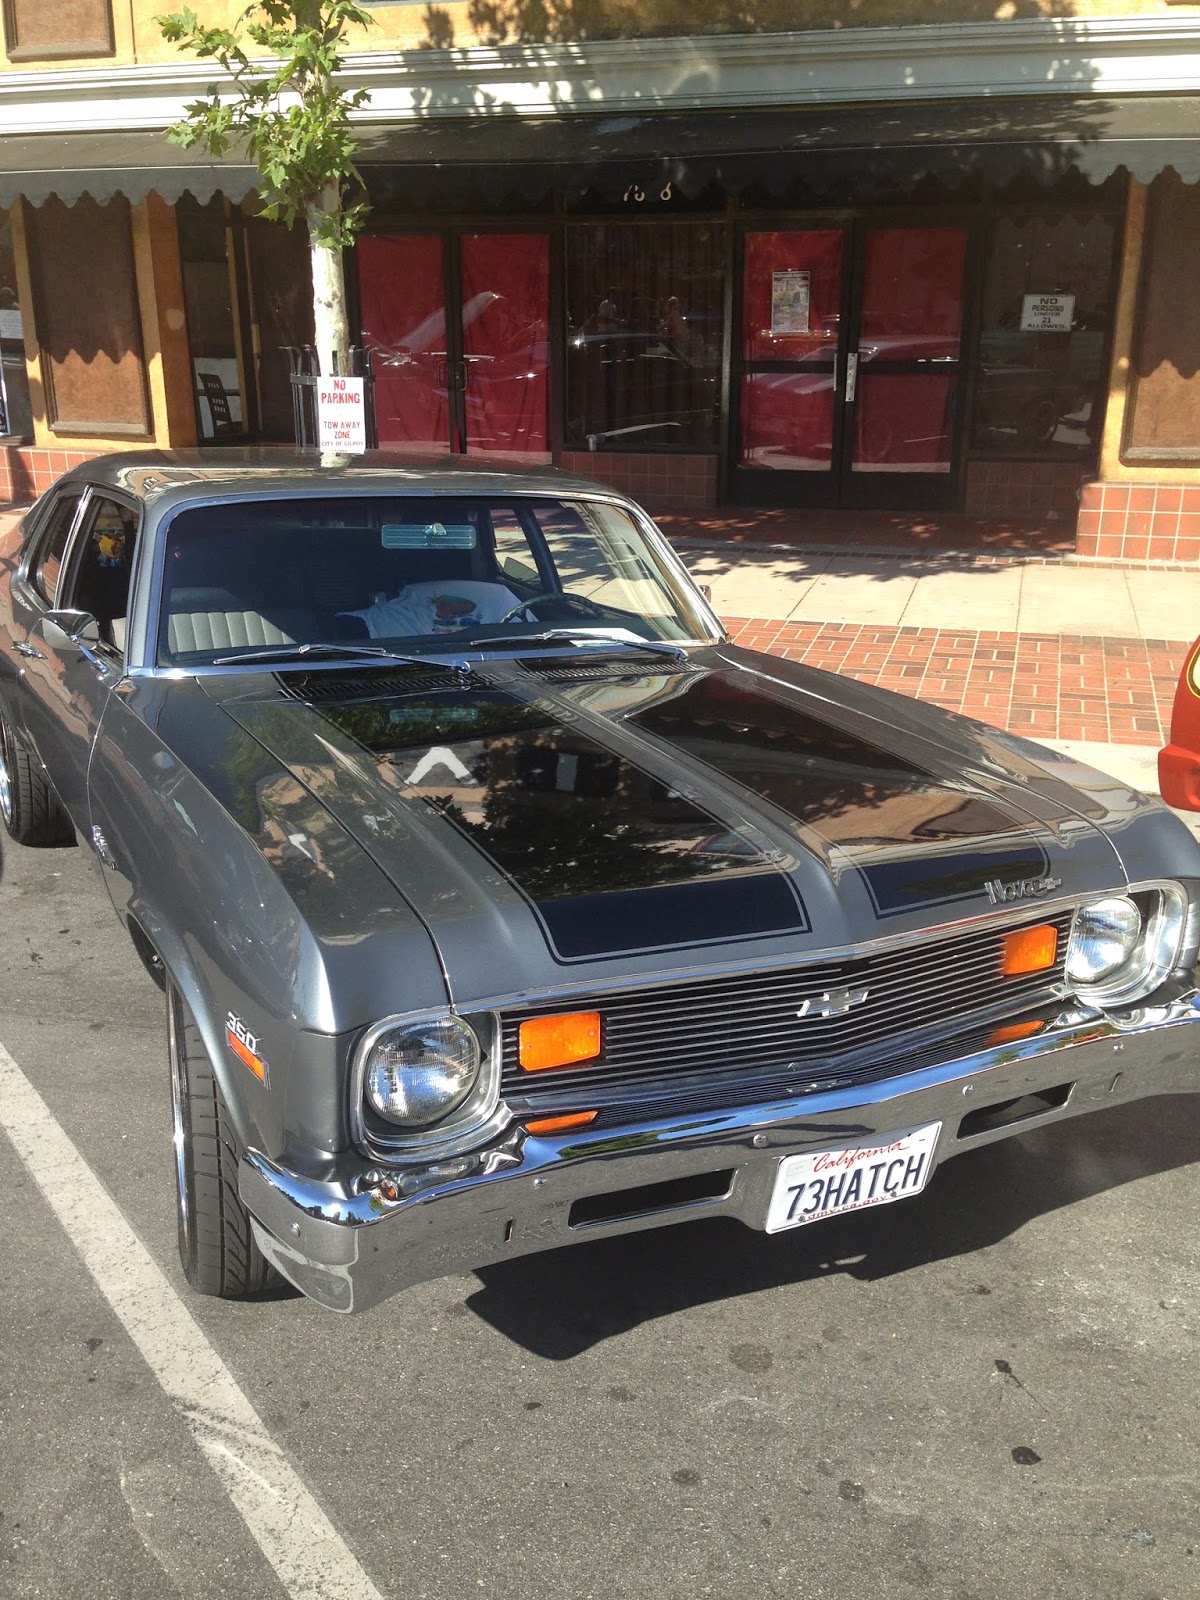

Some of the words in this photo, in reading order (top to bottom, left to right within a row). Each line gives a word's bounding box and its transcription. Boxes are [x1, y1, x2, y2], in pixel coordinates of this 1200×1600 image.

[1040, 297, 1058, 305] NO
[1032, 304, 1064, 312] PERSONS
[1042, 316, 1051, 324] 21
[333, 379, 346, 391] NO
[321, 392, 361, 404] PARKING
[323, 421, 339, 430] TOW
[340, 421, 361, 429] AWAY
[334, 430, 351, 439] ZONE
[984, 878, 1048, 905] Nova
[225, 1011, 257, 1056] 350
[813, 1141, 911, 1173] California
[786, 1152, 926, 1221] 73HATCH
[807, 1195, 888, 1221] dmv.ca.gov
